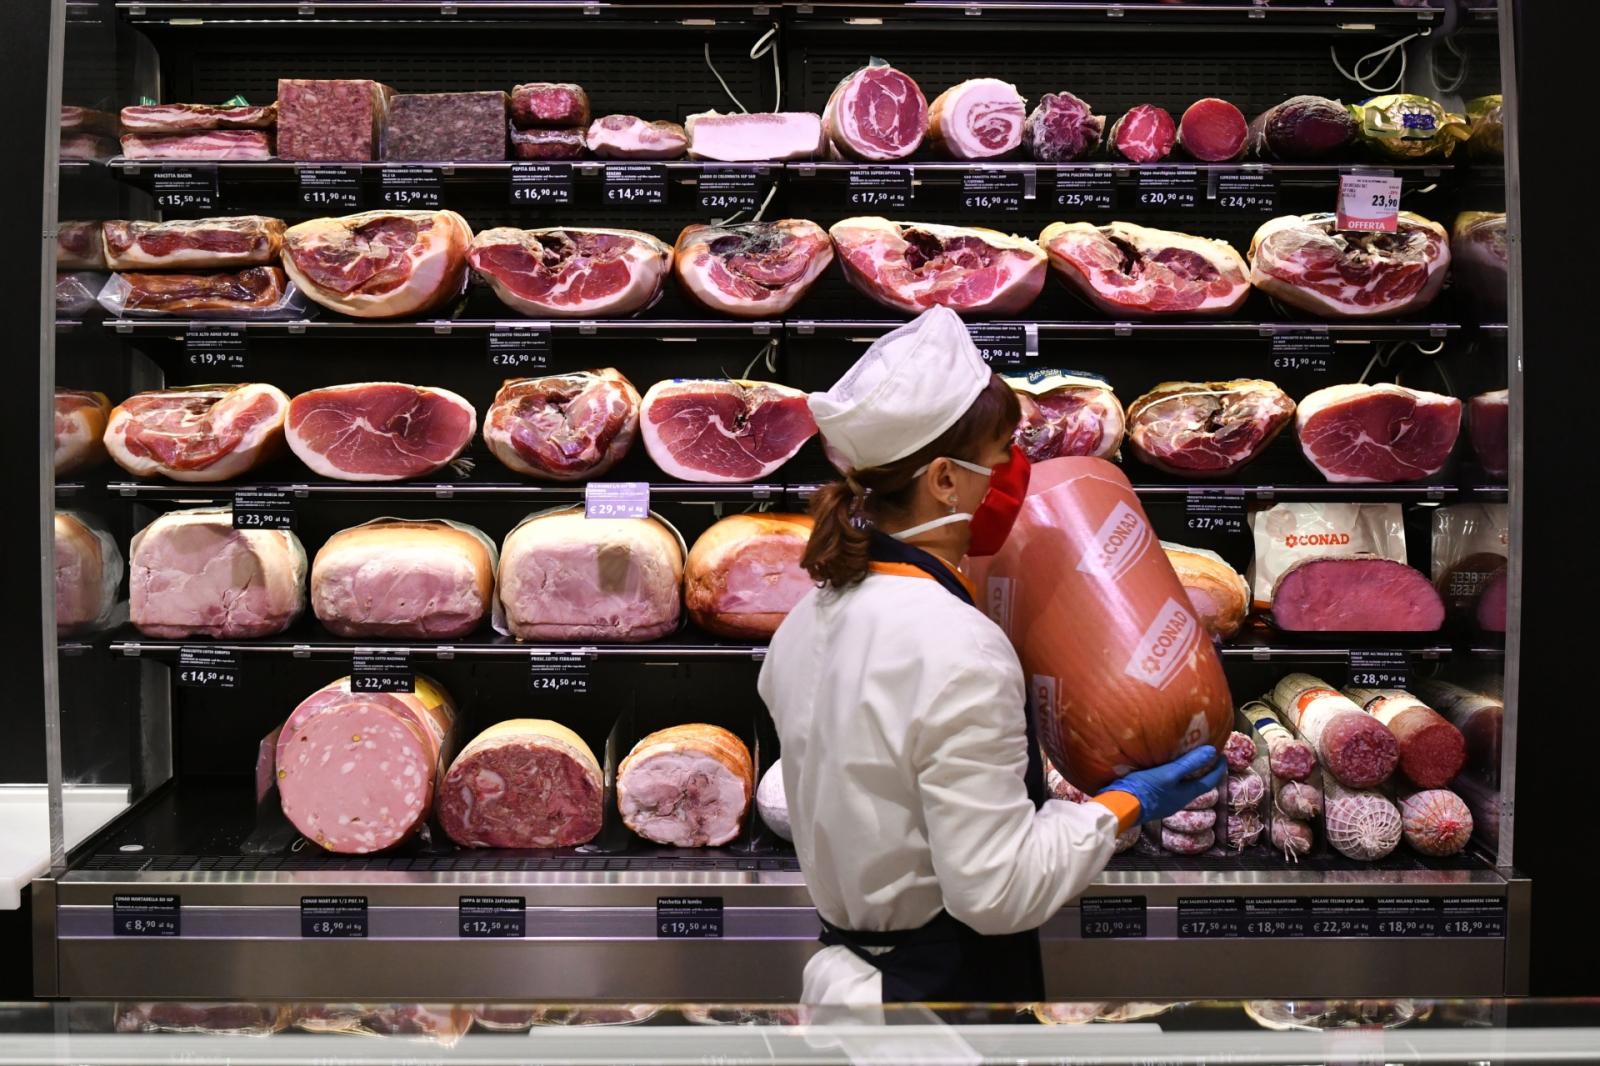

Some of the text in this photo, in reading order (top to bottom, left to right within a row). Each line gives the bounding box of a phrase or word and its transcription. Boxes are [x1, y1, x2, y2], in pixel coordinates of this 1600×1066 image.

[304, 193, 310, 202] €
[313, 192, 339, 204] 11,90
[385, 192, 391, 201] €
[394, 191, 420, 203] 15,90
[514, 190, 521, 199] €
[524, 188, 550, 200] 16,90
[608, 190, 615, 199] €
[618, 188, 644, 200] 14,50
[852, 194, 858, 203] €
[862, 192, 887, 204] 17,50
[1058, 196, 1065, 204] €
[1067, 194, 1093, 206] 25,90
[1141, 194, 1147, 203] €
[1150, 193, 1176, 204] 20,90
[158, 196, 164, 205] €
[167, 195, 193, 206] 15,50
[702, 197, 708, 206] €
[711, 196, 737, 208] 24,90
[966, 198, 972, 207] €
[975, 197, 1001, 208] 16,90
[1220, 198, 1227, 206] €
[1229, 196, 1256, 208] 24,90
[1372, 195, 1397, 207] 23,90
[1348, 221, 1385, 230] OFFERTA
[190, 355, 196, 364] €
[200, 354, 226, 365] 19,90
[493, 356, 498, 364] €
[502, 354, 528, 366] 26,90
[1274, 359, 1280, 367] €
[1283, 358, 1309, 369] 31,90
[590, 505, 597, 514] €
[237, 516, 244, 524] €
[246, 514, 273, 526] 23,90
[1188, 519, 1194, 528] €
[1197, 518, 1223, 530] 27,90
[1103, 512, 1138, 554] CONAD
[1299, 533, 1350, 545] CONAD
[1152, 611, 1187, 657] CONAD
[181, 672, 187, 681] €
[191, 671, 217, 684] 14,50
[365, 678, 391, 689] 22,90
[1353, 675, 1360, 684] €
[1362, 674, 1388, 685] 28,90
[533, 680, 539, 688] €
[542, 678, 569, 690] 24,50
[125, 921, 132, 930] €
[134, 920, 156, 932] 8,90
[313, 923, 320, 932] €
[322, 922, 343, 934] 8,90
[463, 923, 470, 932] €
[473, 922, 501, 934] 12,50
[661, 924, 667, 932] €
[671, 922, 699, 934] 19,50
[1182, 924, 1188, 933] €
[1192, 922, 1219, 934] 17,50
[1248, 923, 1254, 932] €
[1258, 922, 1285, 934] 18,90
[1313, 922, 1320, 932] €
[1323, 921, 1351, 933] 22,50
[1379, 923, 1385, 932] €
[1389, 921, 1416, 934] 18,90
[1445, 923, 1451, 932] €
[1455, 921, 1482, 933] 18,90
